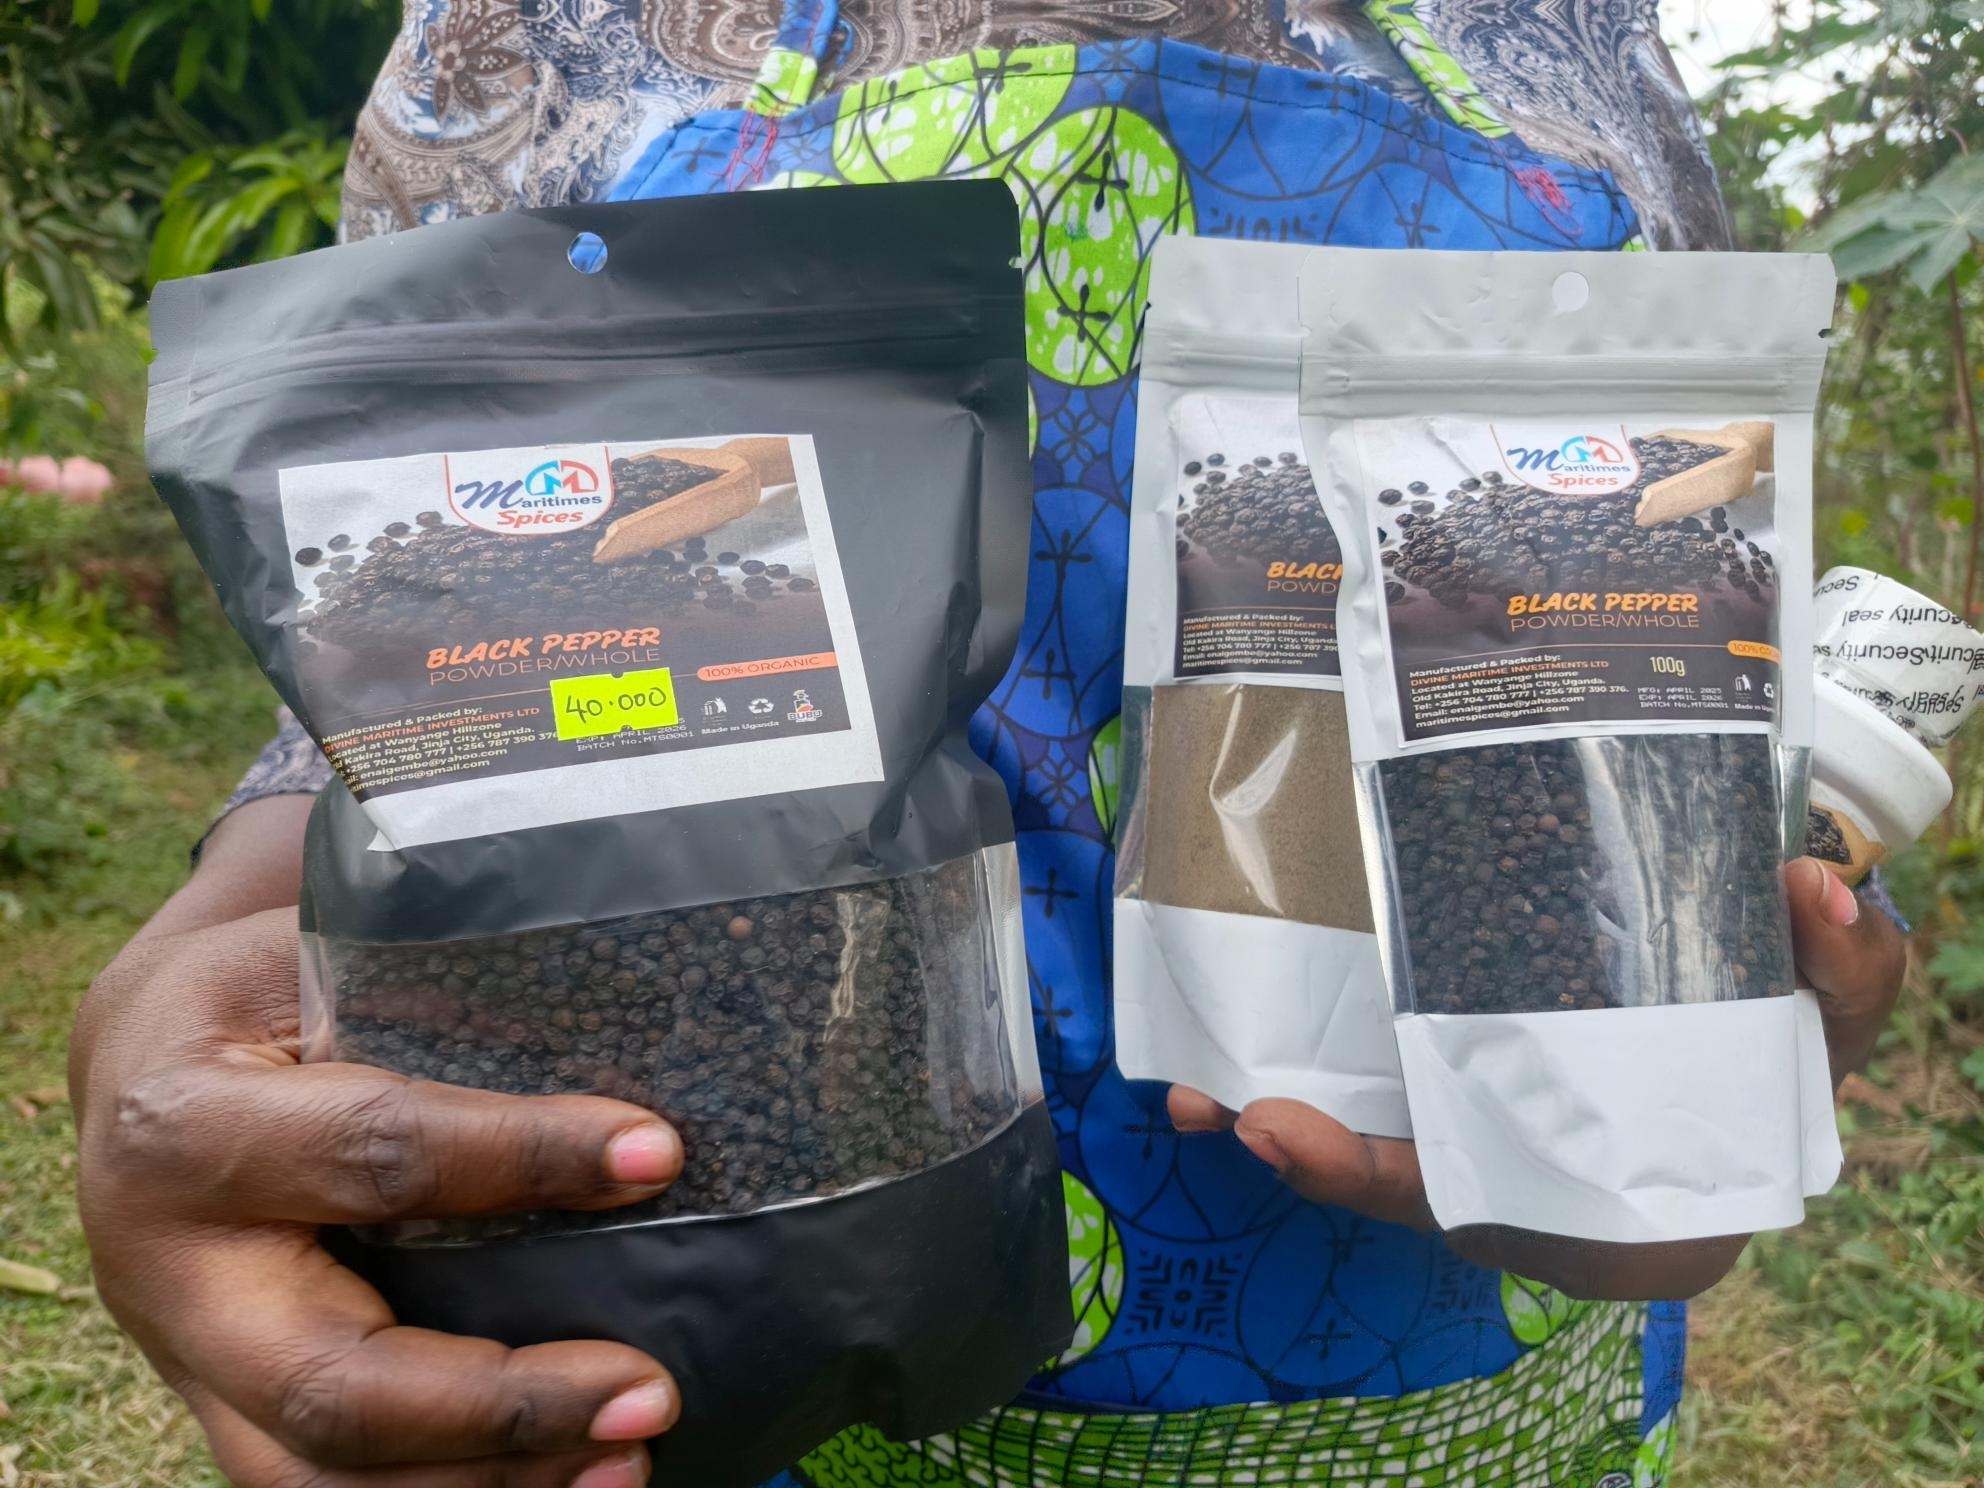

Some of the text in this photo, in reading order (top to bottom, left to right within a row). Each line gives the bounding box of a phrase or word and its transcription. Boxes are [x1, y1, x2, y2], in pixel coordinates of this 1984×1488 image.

[1506, 447, 1631, 472] Maritimes
[1548, 473, 1619, 489] Spices
[454, 479, 602, 509] Maritimes
[497, 509, 583, 528] Spices
[1506, 592, 1699, 615] BLACK PEPPER
[1183, 614, 1241, 624] Manufactured
[1289, 614, 1304, 622] by:
[1183, 623, 1210, 632] DIVINE
[1211, 621, 1256, 629] MARITIME
[1259, 621, 1329, 630] INVESTMENTS
[1510, 613, 1700, 632] POWDER/WHOLE
[1842, 609, 1884, 627] seal
[1183, 630, 1213, 639] Located
[1183, 638, 1196, 646] Old
[1197, 636, 1223, 644] Kakira
[426, 627, 661, 669] BLACK PEPPER
[1836, 640, 1925, 666] Security
[430, 649, 661, 686] POWDER/WHOLE
[706, 656, 820, 678] 100% ORGANIC
[1409, 661, 1487, 678] Manufactured
[1500, 655, 1542, 665] Packed
[1544, 654, 1561, 662] by:
[1410, 660, 1609, 687] DIVINE MARITIME INVESTMENTS LTD
[1649, 656, 1686, 677] 100g
[1411, 682, 1455, 695] Located
[1471, 675, 1532, 686] Wanyange
[1534, 670, 1579, 679] Hillzone
[1412, 678, 1606, 703] Old Kakira Road, Jinja City, Uganda.
[1414, 703, 1433, 711] Tel:
[1434, 699, 1460, 708] +256
[1462, 696, 1484, 704] 704
[1485, 692, 1507, 701] 780
[1509, 691, 1530, 699] 777
[1540, 688, 1565, 696] +256
[1566, 686, 1586, 694] 787
[1415, 695, 1585, 719] Email: enaigembe@yahoo.com
[322, 707, 483, 744] Manufactured & Packed by:
[701, 725, 728, 734] Made
[742, 720, 780, 730] Uganda
[1416, 705, 1570, 728] maritimespices@gmail.com
[324, 707, 540, 754] DIVINE MARITIME INVESTMENTS LTD
[369, 742, 381, 750] at
[384, 730, 450, 747] Wanyange
[452, 722, 502, 734] Hillzone
[613, 730, 649, 740] APRIL
[657, 725, 687, 734] 2026
[345, 752, 381, 765] Kakira
[384, 744, 420, 755] Road,
[422, 739, 450, 750] Jinja
[453, 735, 480, 744] City,
[483, 726, 535, 739] Uganda.
[346, 762, 371, 773] +256
[373, 756, 396, 767] 704
[399, 752, 422, 762] 780
[425, 748, 447, 758] 777
[456, 742, 485, 751] +256
[488, 738, 510, 747] 787
[513, 735, 535, 743] 390
[577, 741, 615, 752] BATCH
[351, 759, 490, 792] timespices@gmail.com
[360, 748, 508, 779] enaigembe@yahoo.com
